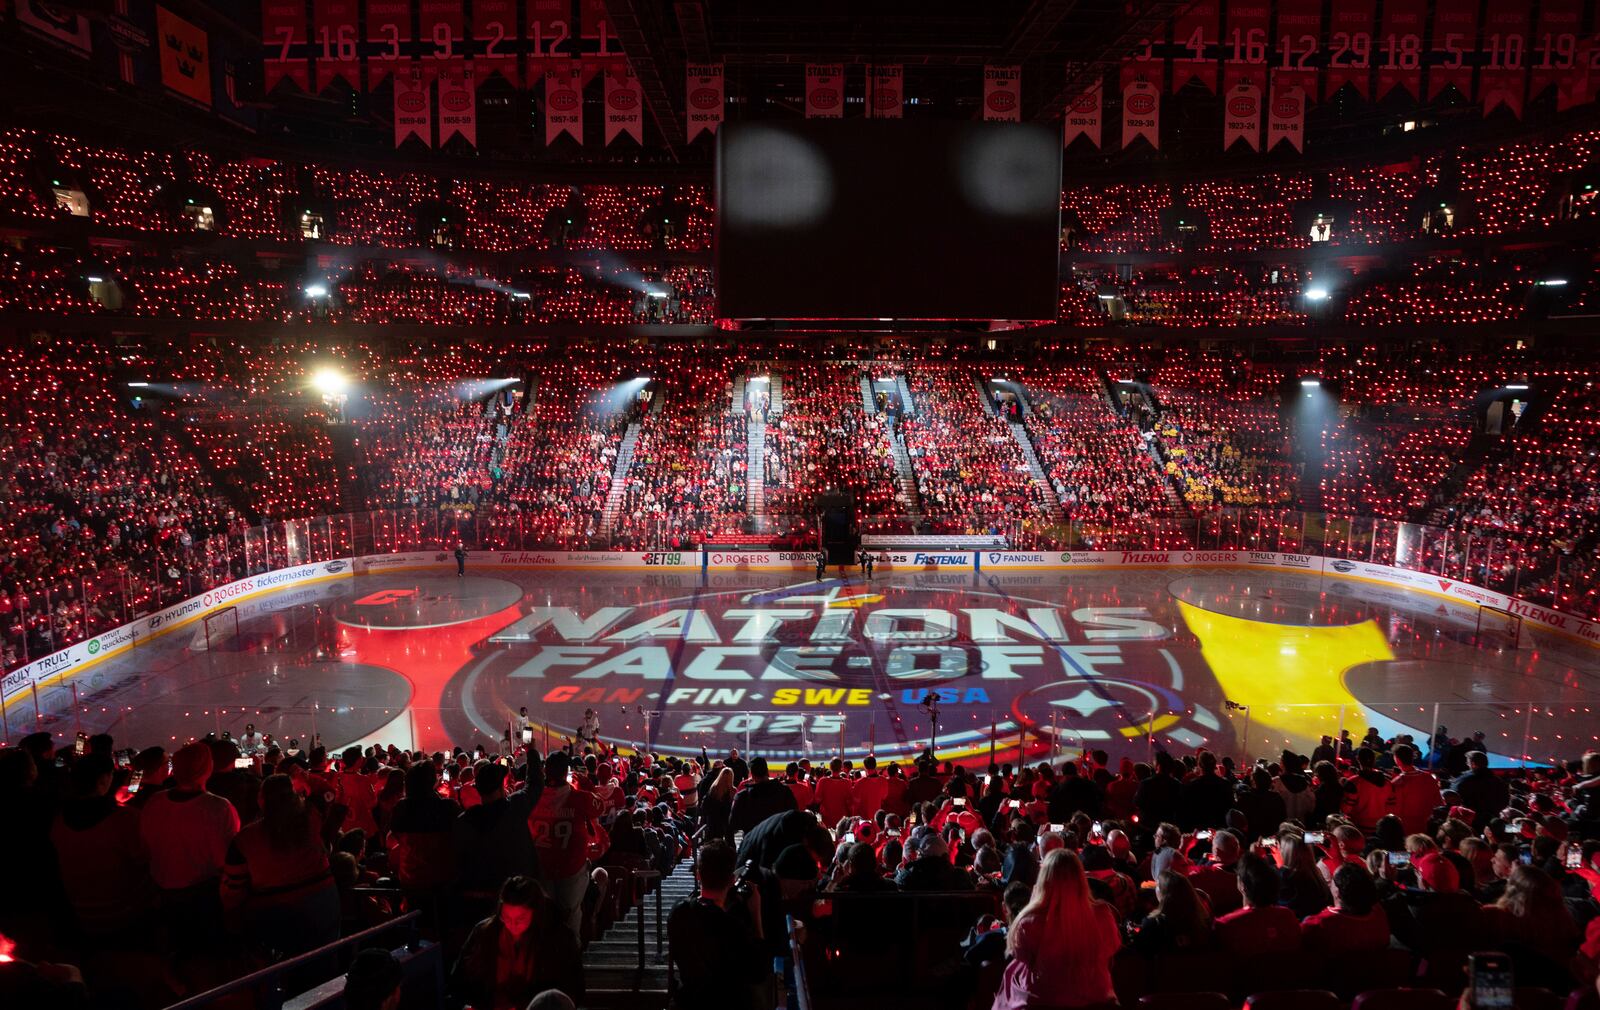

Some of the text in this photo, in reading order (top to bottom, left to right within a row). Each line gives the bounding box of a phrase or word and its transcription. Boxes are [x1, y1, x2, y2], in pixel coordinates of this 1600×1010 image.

[275, 26, 294, 63] 7
[320, 24, 357, 62] 16
[380, 23, 400, 61] 3
[432, 22, 453, 60] 9
[485, 21, 505, 59] 2
[530, 20, 569, 58] 12
[596, 19, 612, 57] 1
[1185, 25, 1207, 64] 4
[1231, 27, 1266, 65] 16
[1280, 34, 1317, 71] 12
[1330, 31, 1371, 68] 29
[1384, 33, 1420, 70] 18
[1443, 33, 1465, 70] 5
[1487, 33, 1524, 71] 10
[1542, 33, 1576, 70] 19
[688, 68, 722, 77] STANLEY
[807, 67, 842, 77] STANLEY
[986, 71, 1020, 80] STANLEY
[1070, 118, 1097, 126] 1930-31
[1127, 119, 1155, 127] 1929-30
[1229, 122, 1255, 130] 1923-24
[500, 552, 556, 564] Tim Hortons
[726, 554, 770, 564] ROGERS
[914, 553, 968, 565] FASTENAL
[1003, 555, 1045, 563] FANDUEL
[1121, 551, 1170, 564] TYLENOL
[1196, 552, 1238, 562] ROGERS
[1249, 552, 1276, 561] TRULY
[1282, 554, 1311, 563] TRULY
[257, 567, 317, 588] ticketmaster
[214, 581, 254, 603] ROGERS
[165, 600, 201, 622] HYUNDAI
[1506, 596, 1567, 629] TYLENOL
[489, 605, 1172, 643] NATIONS
[101, 631, 140, 651] quickbooks
[37, 650, 70, 671] TRULY
[506, 645, 1125, 682] FACE-OFF
[2, 666, 31, 690] TRULY
[542, 685, 992, 706] CAN FIN SWE USA
[679, 714, 847, 734] 2025
[534, 820, 574, 849] 29
